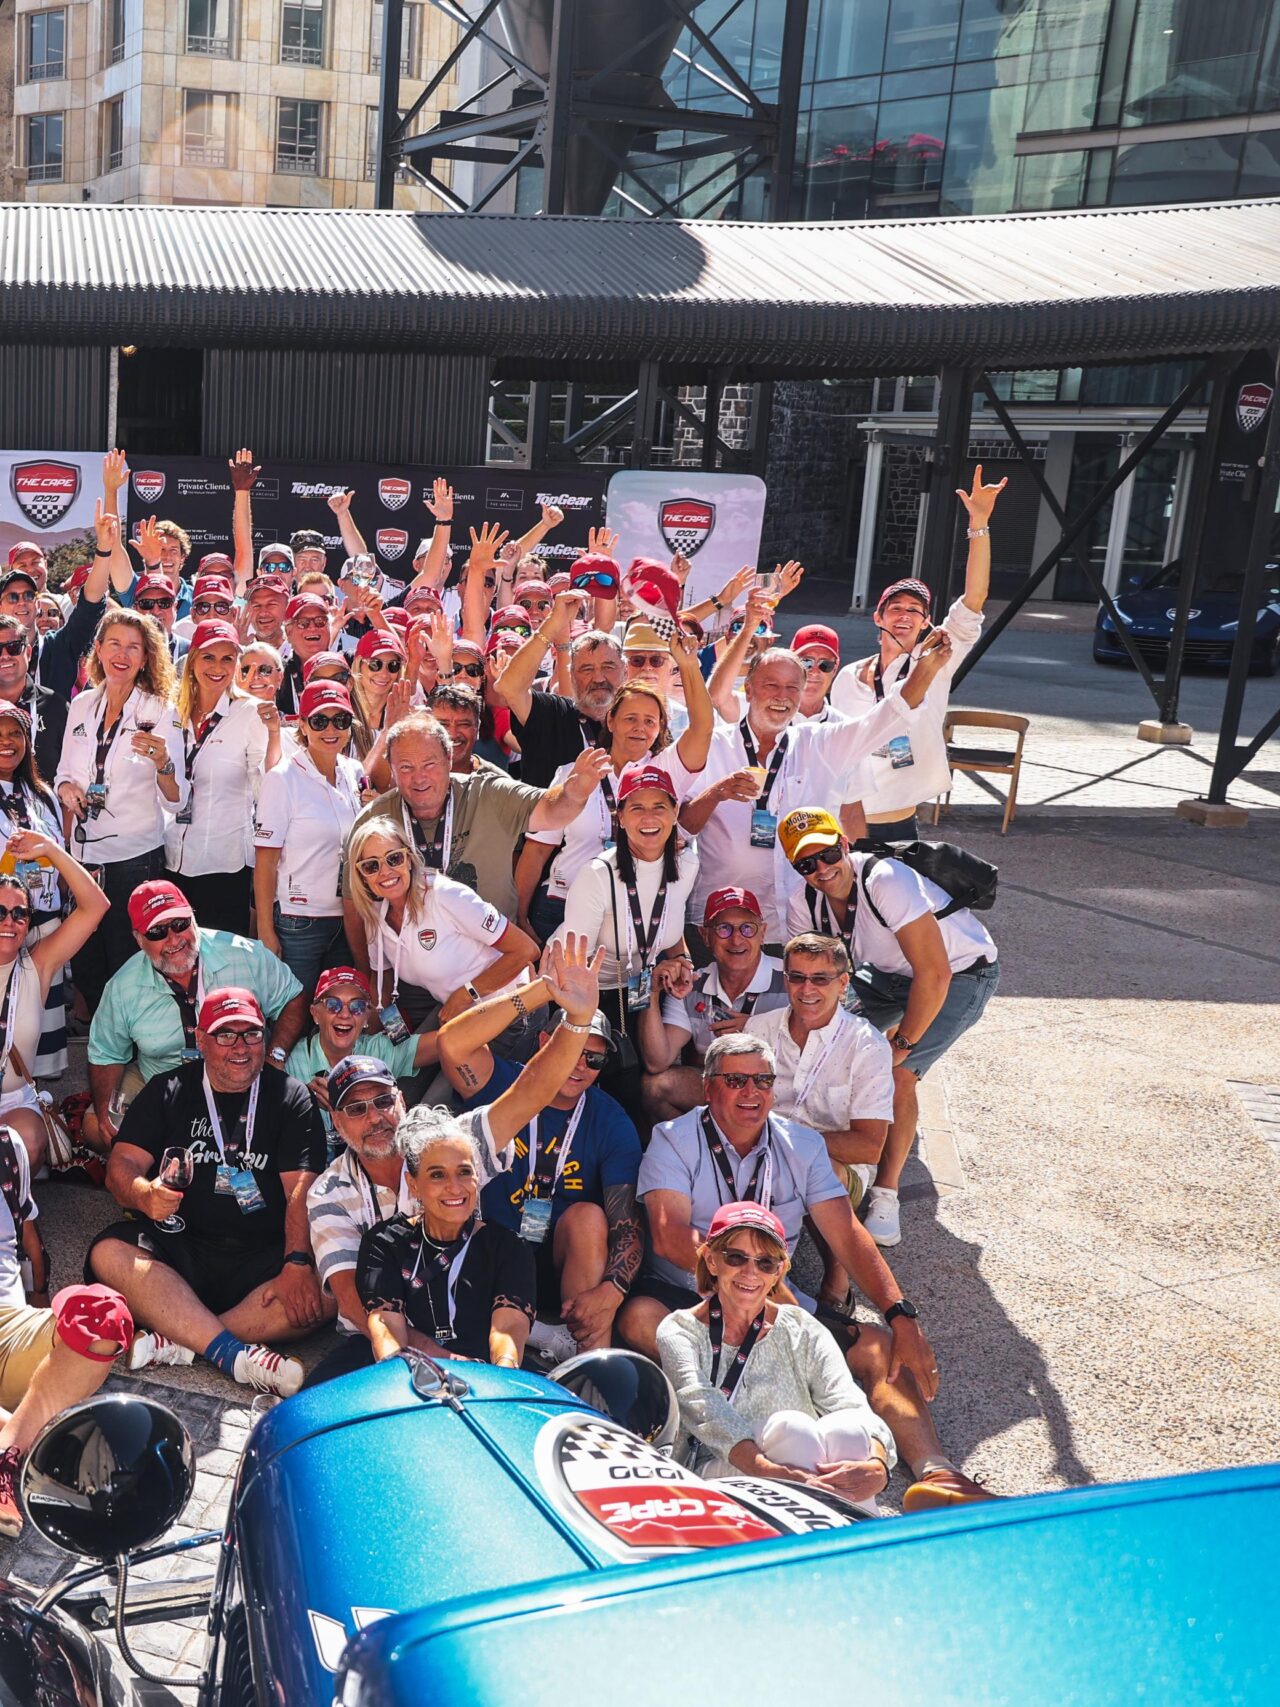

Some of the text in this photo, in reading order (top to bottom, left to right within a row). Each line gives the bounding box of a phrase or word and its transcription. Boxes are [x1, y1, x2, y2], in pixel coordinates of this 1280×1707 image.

[16, 478, 74, 487] THE CAPE
[291, 482, 348, 496] TopGear
[535, 493, 593, 506] TopGear
[191, 1117, 214, 1137] the
[609, 1466, 685, 1480] 1000
[602, 1498, 706, 1523] CAPE
[720, 1479, 833, 1533] opGear
